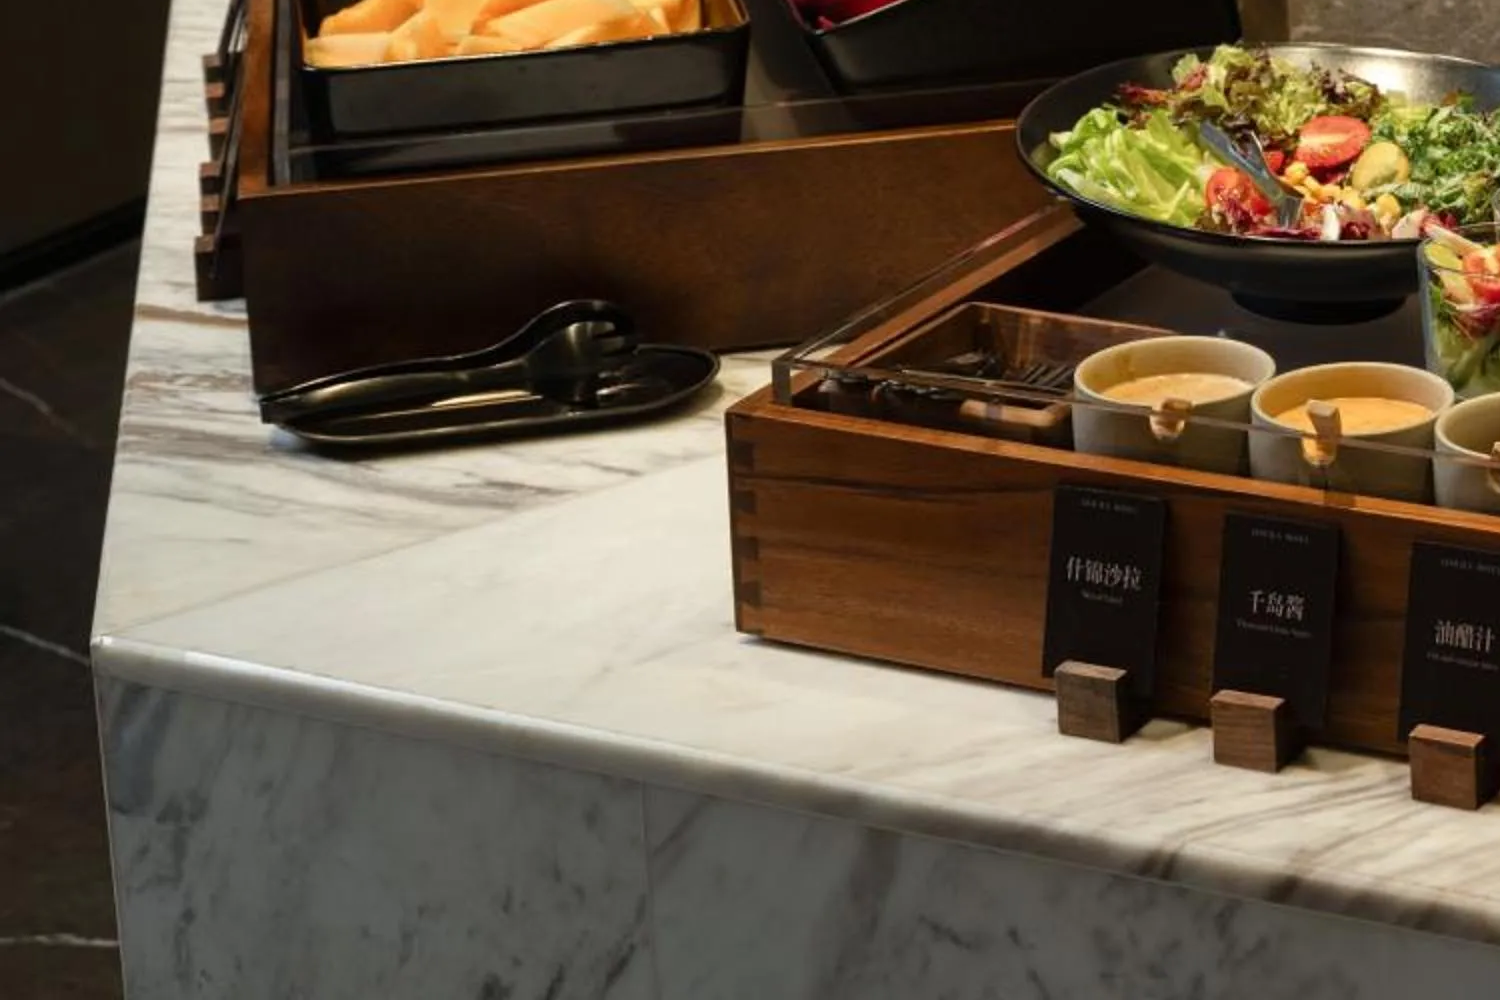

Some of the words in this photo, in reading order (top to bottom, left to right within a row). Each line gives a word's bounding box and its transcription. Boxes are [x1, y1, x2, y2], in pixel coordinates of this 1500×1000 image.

[1066, 556, 1142, 591] 什锦沙拉
[1249, 590, 1305, 621] 千岛酱
[1434, 619, 1495, 653] 油醋汁
